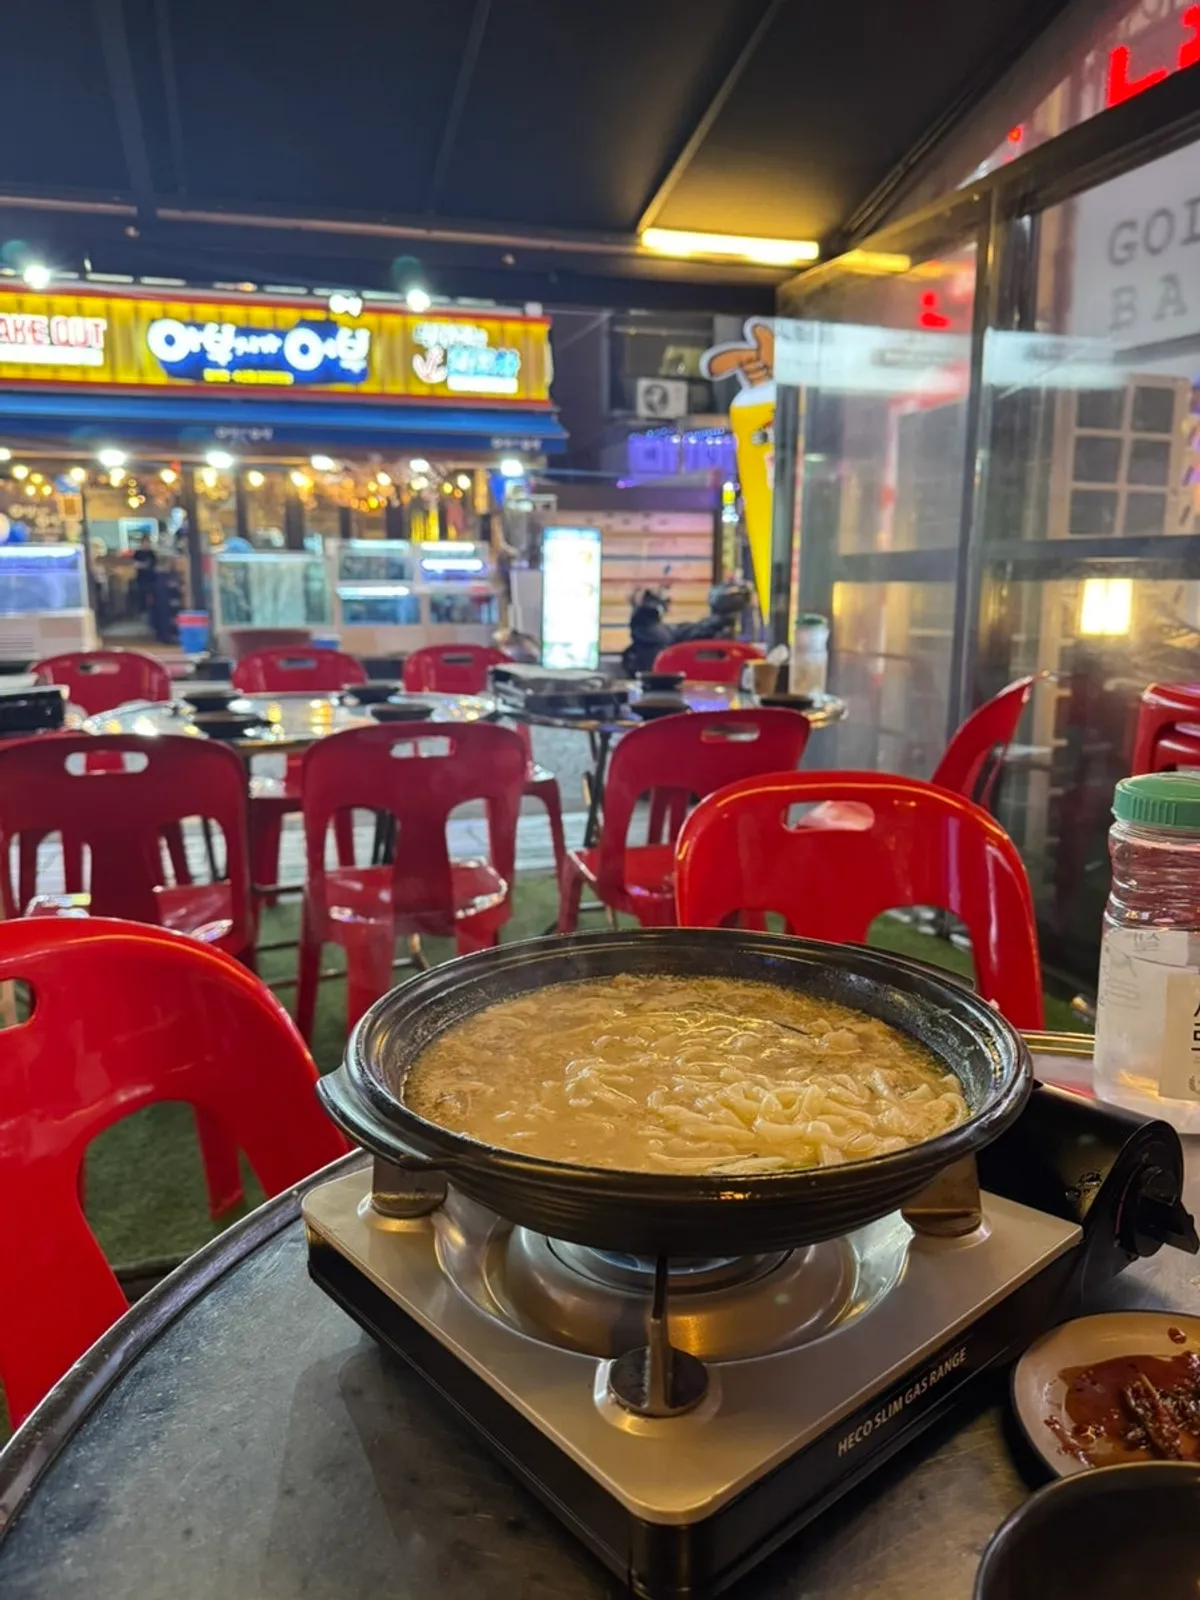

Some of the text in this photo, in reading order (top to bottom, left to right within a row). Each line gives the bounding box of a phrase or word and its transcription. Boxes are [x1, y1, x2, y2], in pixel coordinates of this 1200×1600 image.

[51, 316, 107, 348] OUT
[837, 1347, 967, 1457] HECO SLIM GAS RANGE
